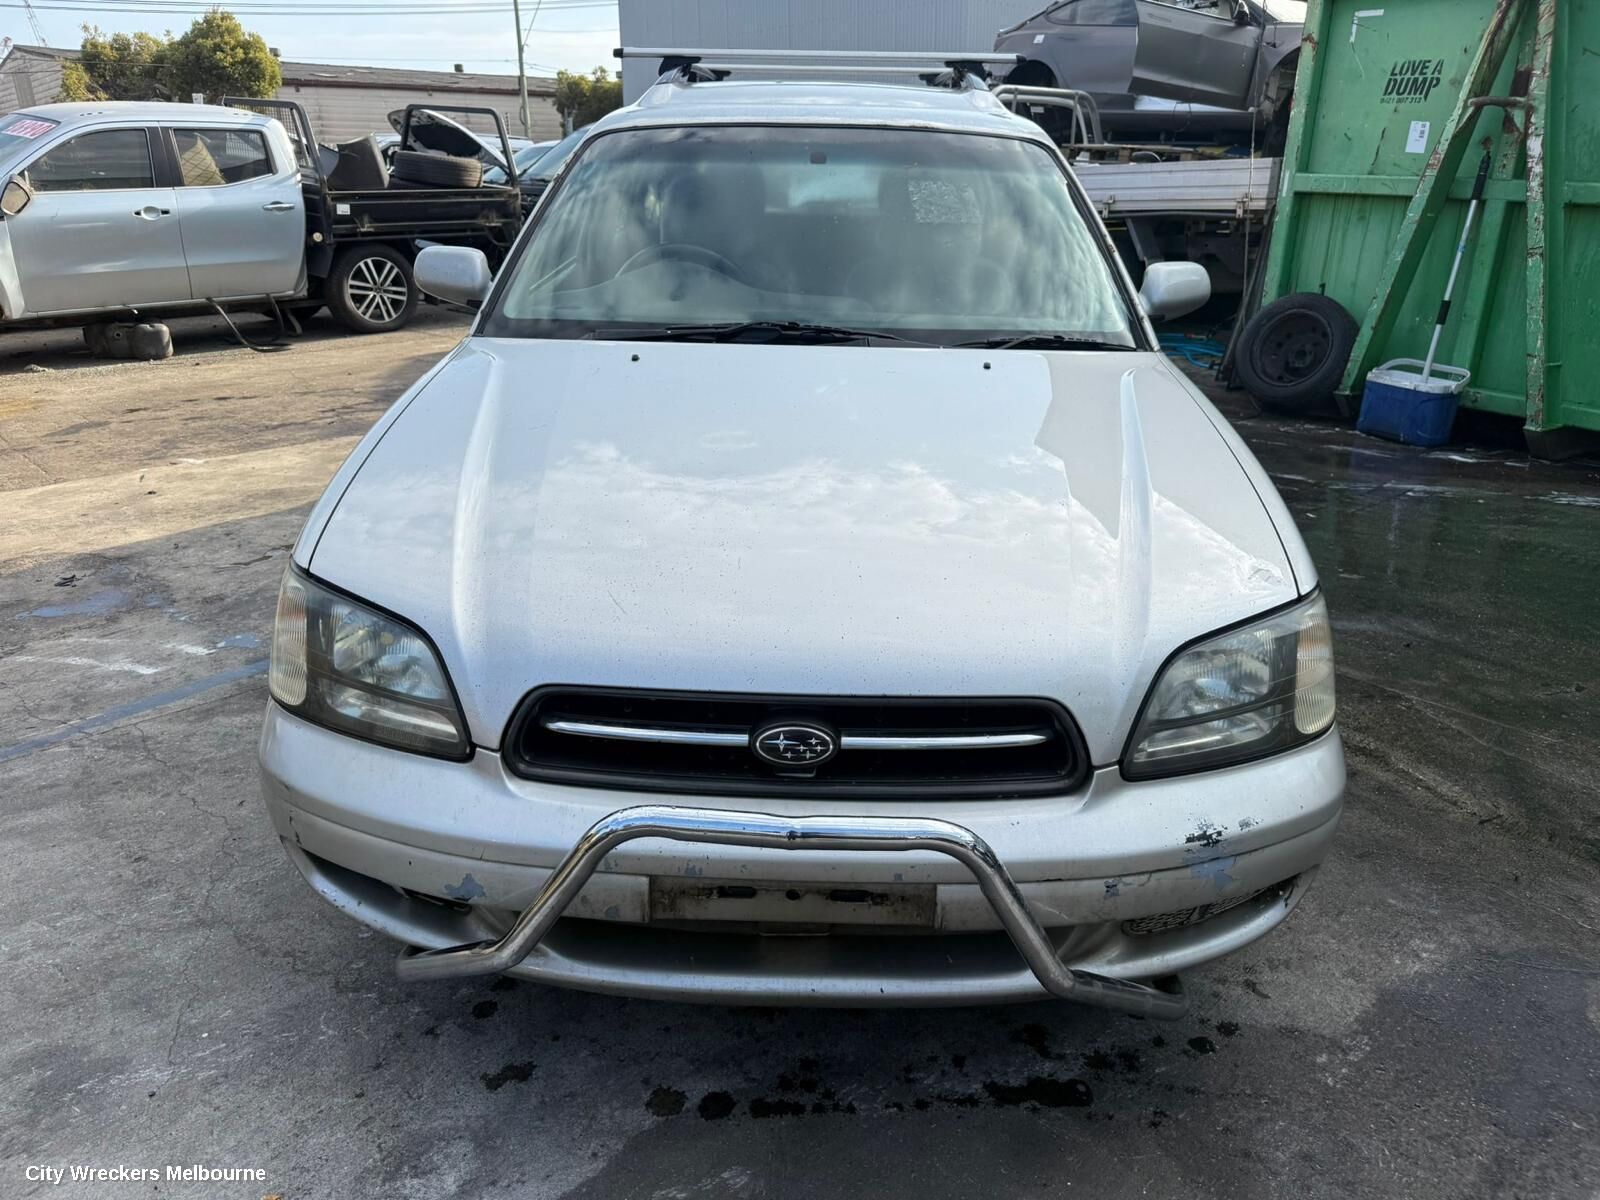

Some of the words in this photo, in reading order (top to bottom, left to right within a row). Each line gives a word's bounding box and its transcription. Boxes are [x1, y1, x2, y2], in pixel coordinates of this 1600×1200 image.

[1390, 59, 1432, 77] LOVE
[1430, 59, 1444, 76] A
[1382, 76, 1441, 102] DUMP
